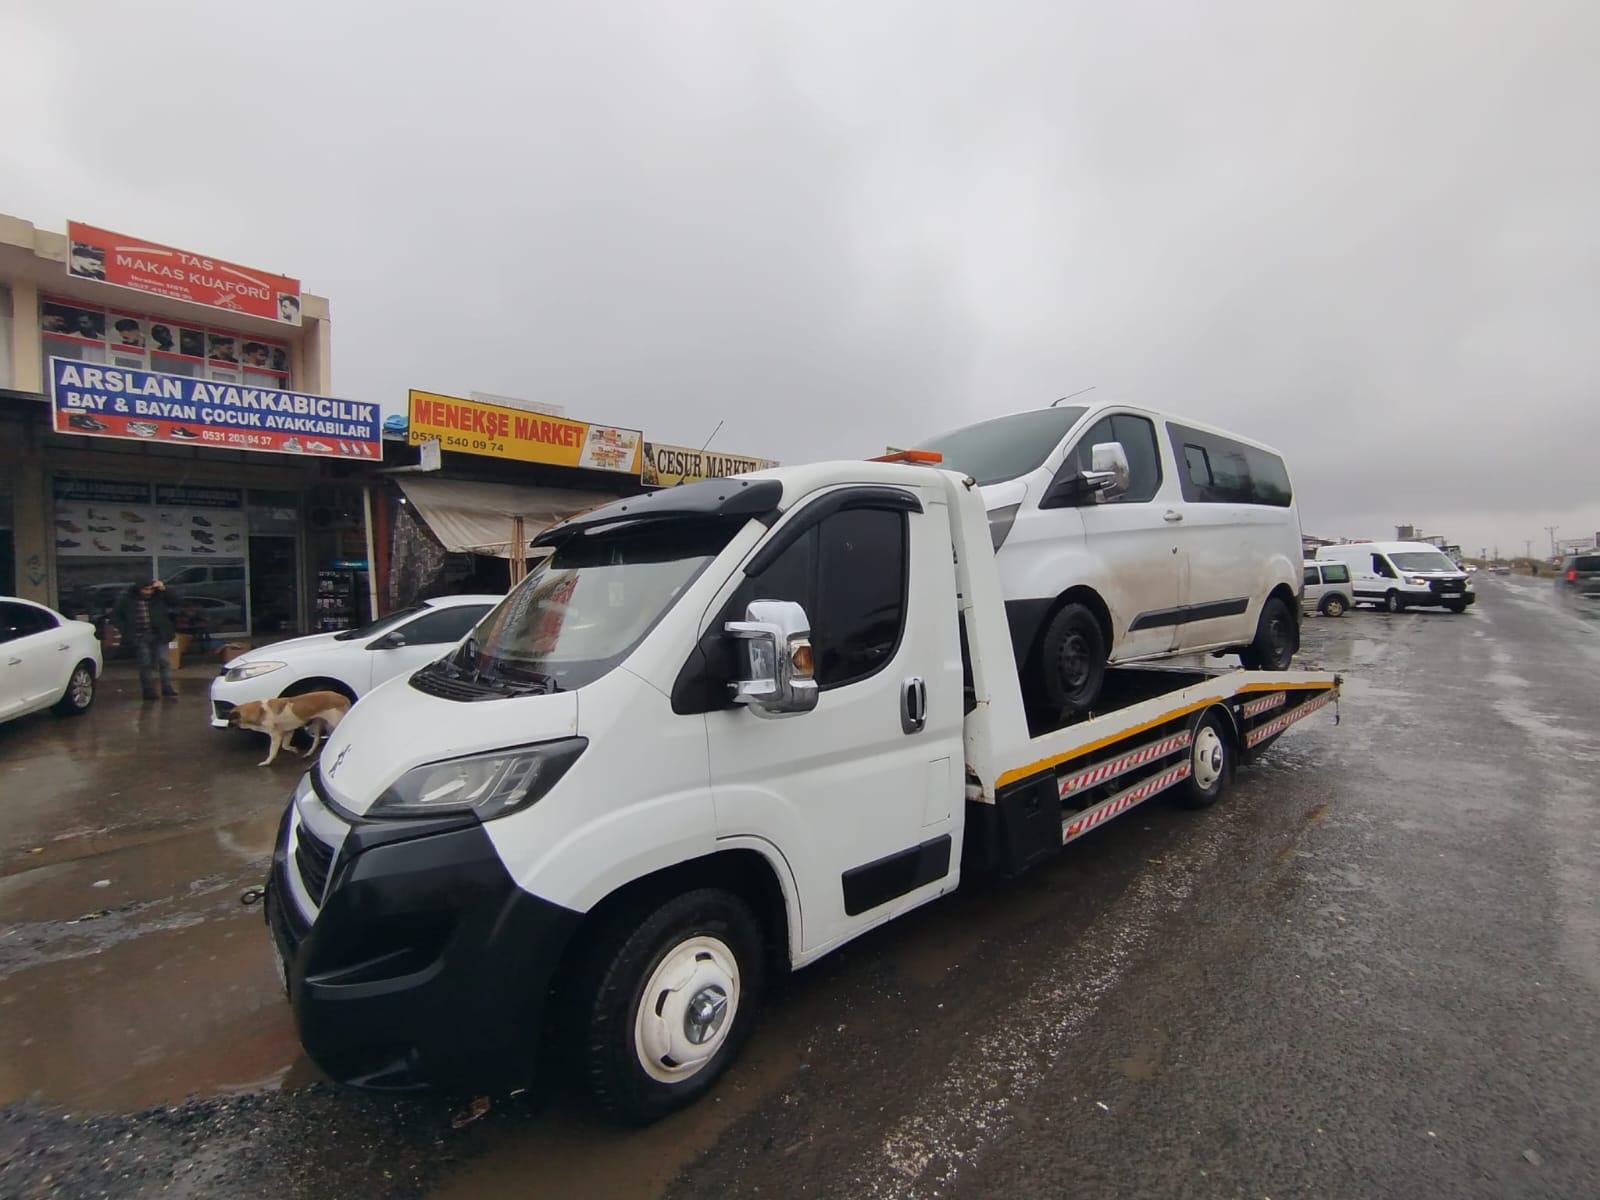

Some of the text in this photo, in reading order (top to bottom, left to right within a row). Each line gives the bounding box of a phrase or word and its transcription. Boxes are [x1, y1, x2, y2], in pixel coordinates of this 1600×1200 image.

[116, 254, 185, 281] MAKAS
[189, 272, 271, 300] KUAFÖRÜ
[60, 365, 373, 422] ARSLAN AYAKKABICILIK
[67, 391, 371, 438] BAY & BAYAN ÇOCUK AYAKKABILARI
[202, 430, 272, 445] 0531 203 94 37
[414, 398, 584, 448] MENEKŞE MARKET
[447, 436, 468, 447] 540
[473, 440, 487, 449] 09
[490, 442, 504, 452] 74
[657, 449, 702, 478] CESUR
